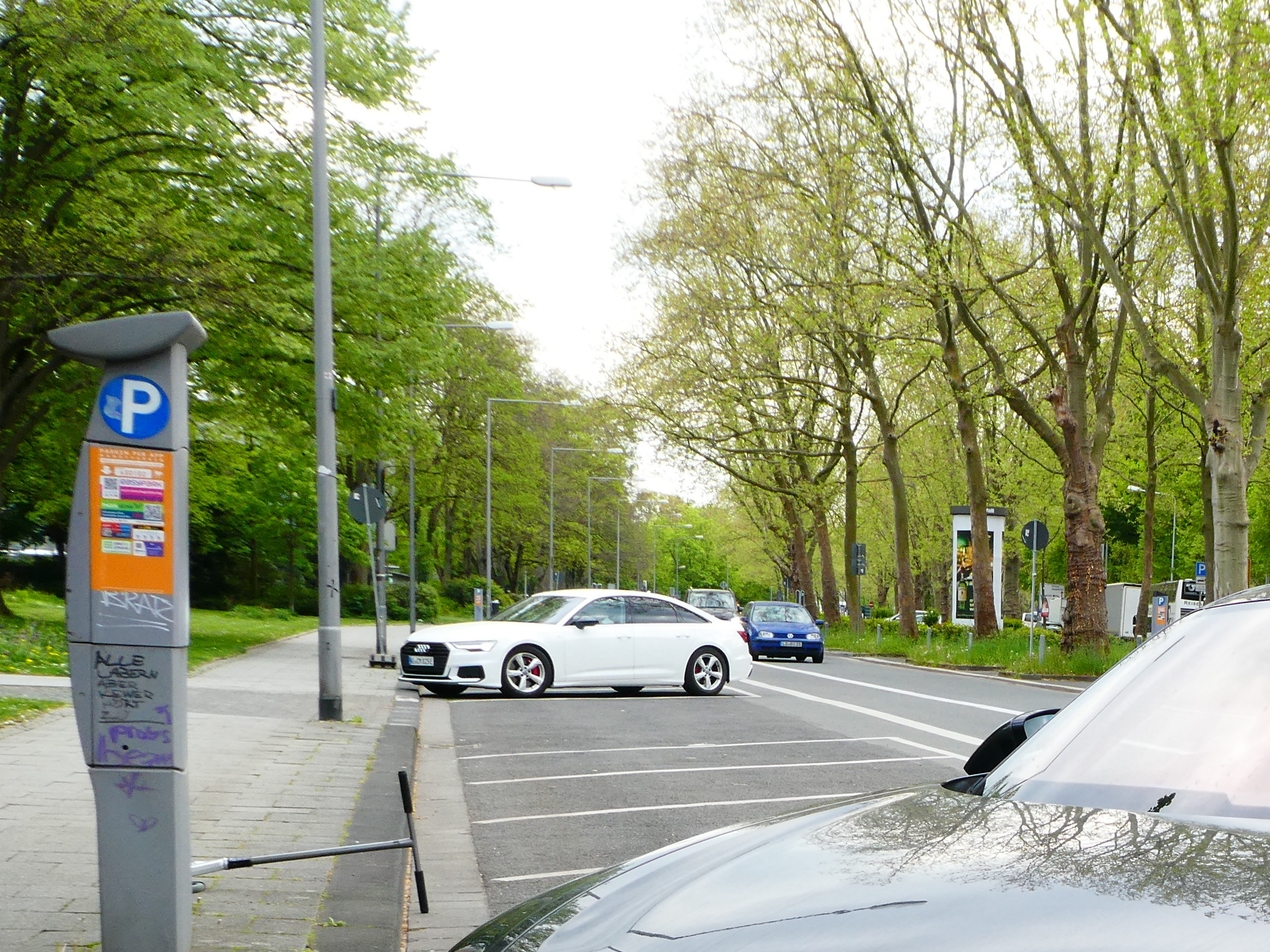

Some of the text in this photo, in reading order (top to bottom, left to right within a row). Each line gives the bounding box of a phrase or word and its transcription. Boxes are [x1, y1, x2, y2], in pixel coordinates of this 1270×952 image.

[122, 379, 161, 434] P
[1198, 564, 1206, 575] P
[95, 651, 145, 669] ALLE
